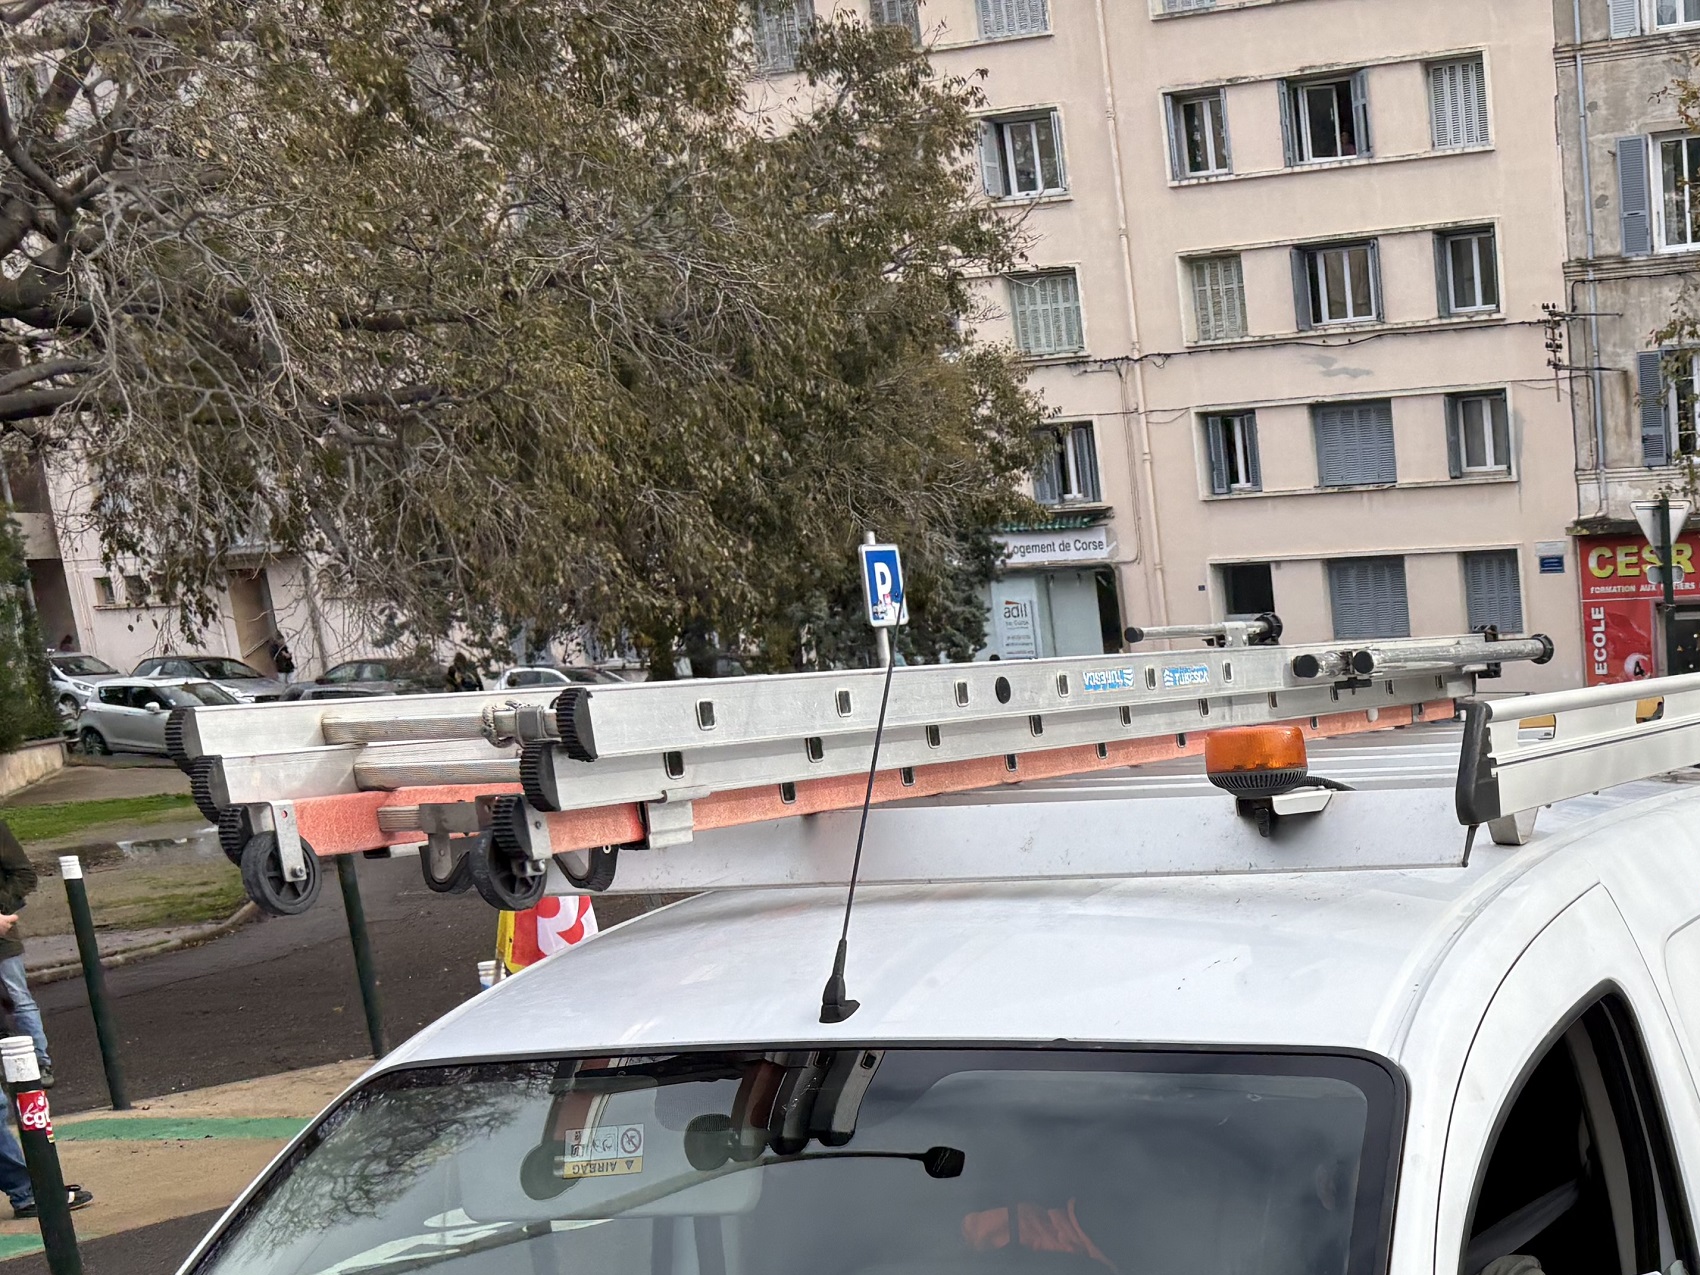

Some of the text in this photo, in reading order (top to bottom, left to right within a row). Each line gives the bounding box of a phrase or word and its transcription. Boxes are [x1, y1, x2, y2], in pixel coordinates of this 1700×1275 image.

[1058, 540, 1071, 552] de
[1074, 539, 1104, 551] Corse
[874, 562, 892, 602] P
[1590, 584, 1636, 595] FORMATION
[1591, 607, 1608, 675] ECOLE
[22, 1110, 53, 1130] cg
[572, 1160, 618, 1175] AIRBAG
